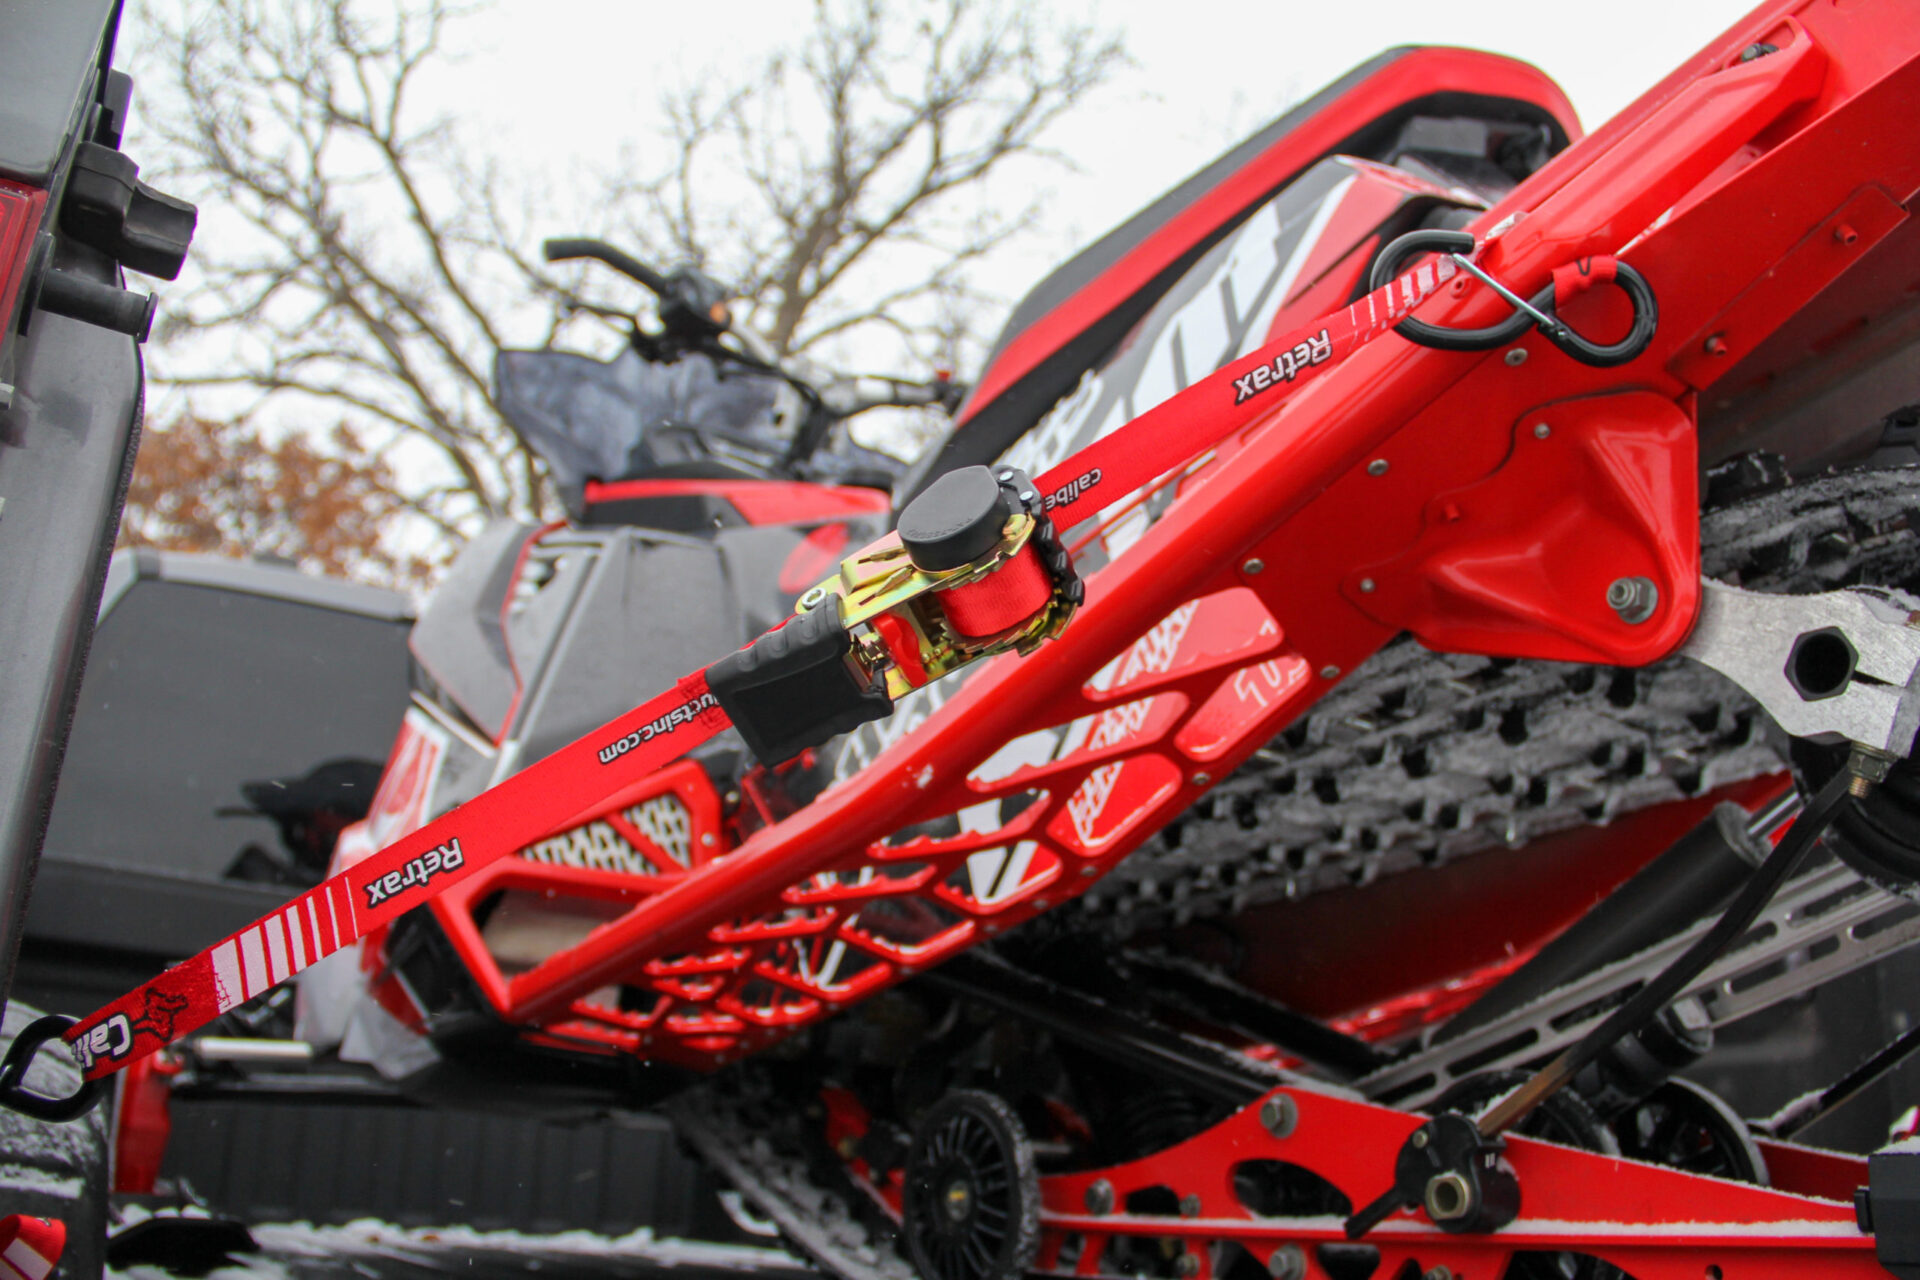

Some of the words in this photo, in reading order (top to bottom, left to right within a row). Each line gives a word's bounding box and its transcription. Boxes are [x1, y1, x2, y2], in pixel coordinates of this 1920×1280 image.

[1233, 328, 1333, 404] Retrax
[1044, 468, 1103, 512] calibe
[598, 692, 719, 764] uctsinc.com
[364, 837, 465, 907] Retrax
[71, 1013, 132, 1069] Cali
